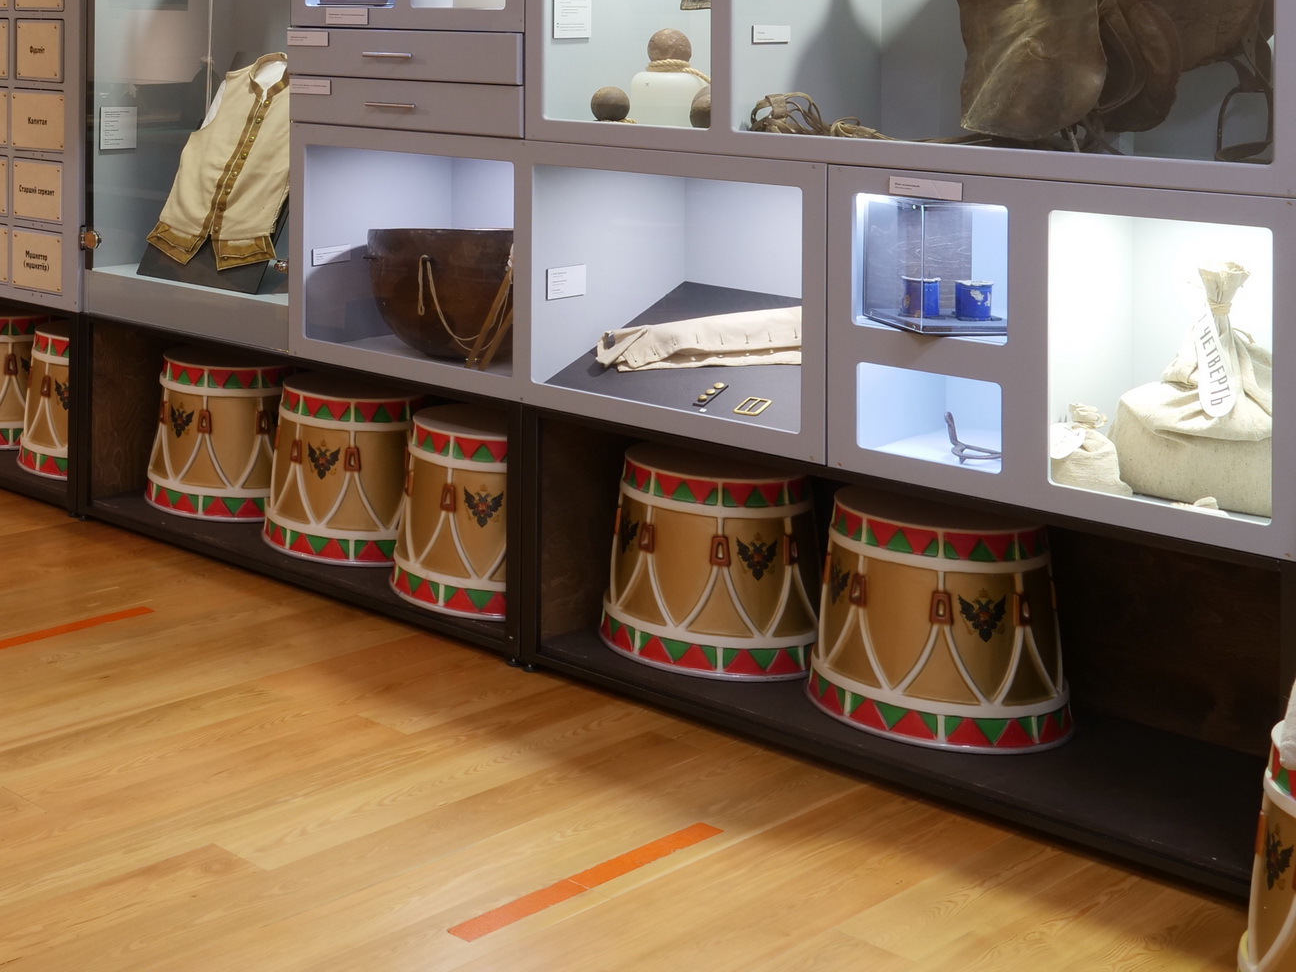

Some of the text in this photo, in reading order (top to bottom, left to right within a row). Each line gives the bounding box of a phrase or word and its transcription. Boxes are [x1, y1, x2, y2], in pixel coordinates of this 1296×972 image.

[28, 117, 47, 125] Капитан
[19, 184, 36, 194] Старший
[1200, 326, 1231, 406] ЧЕТВЕРТЬ
